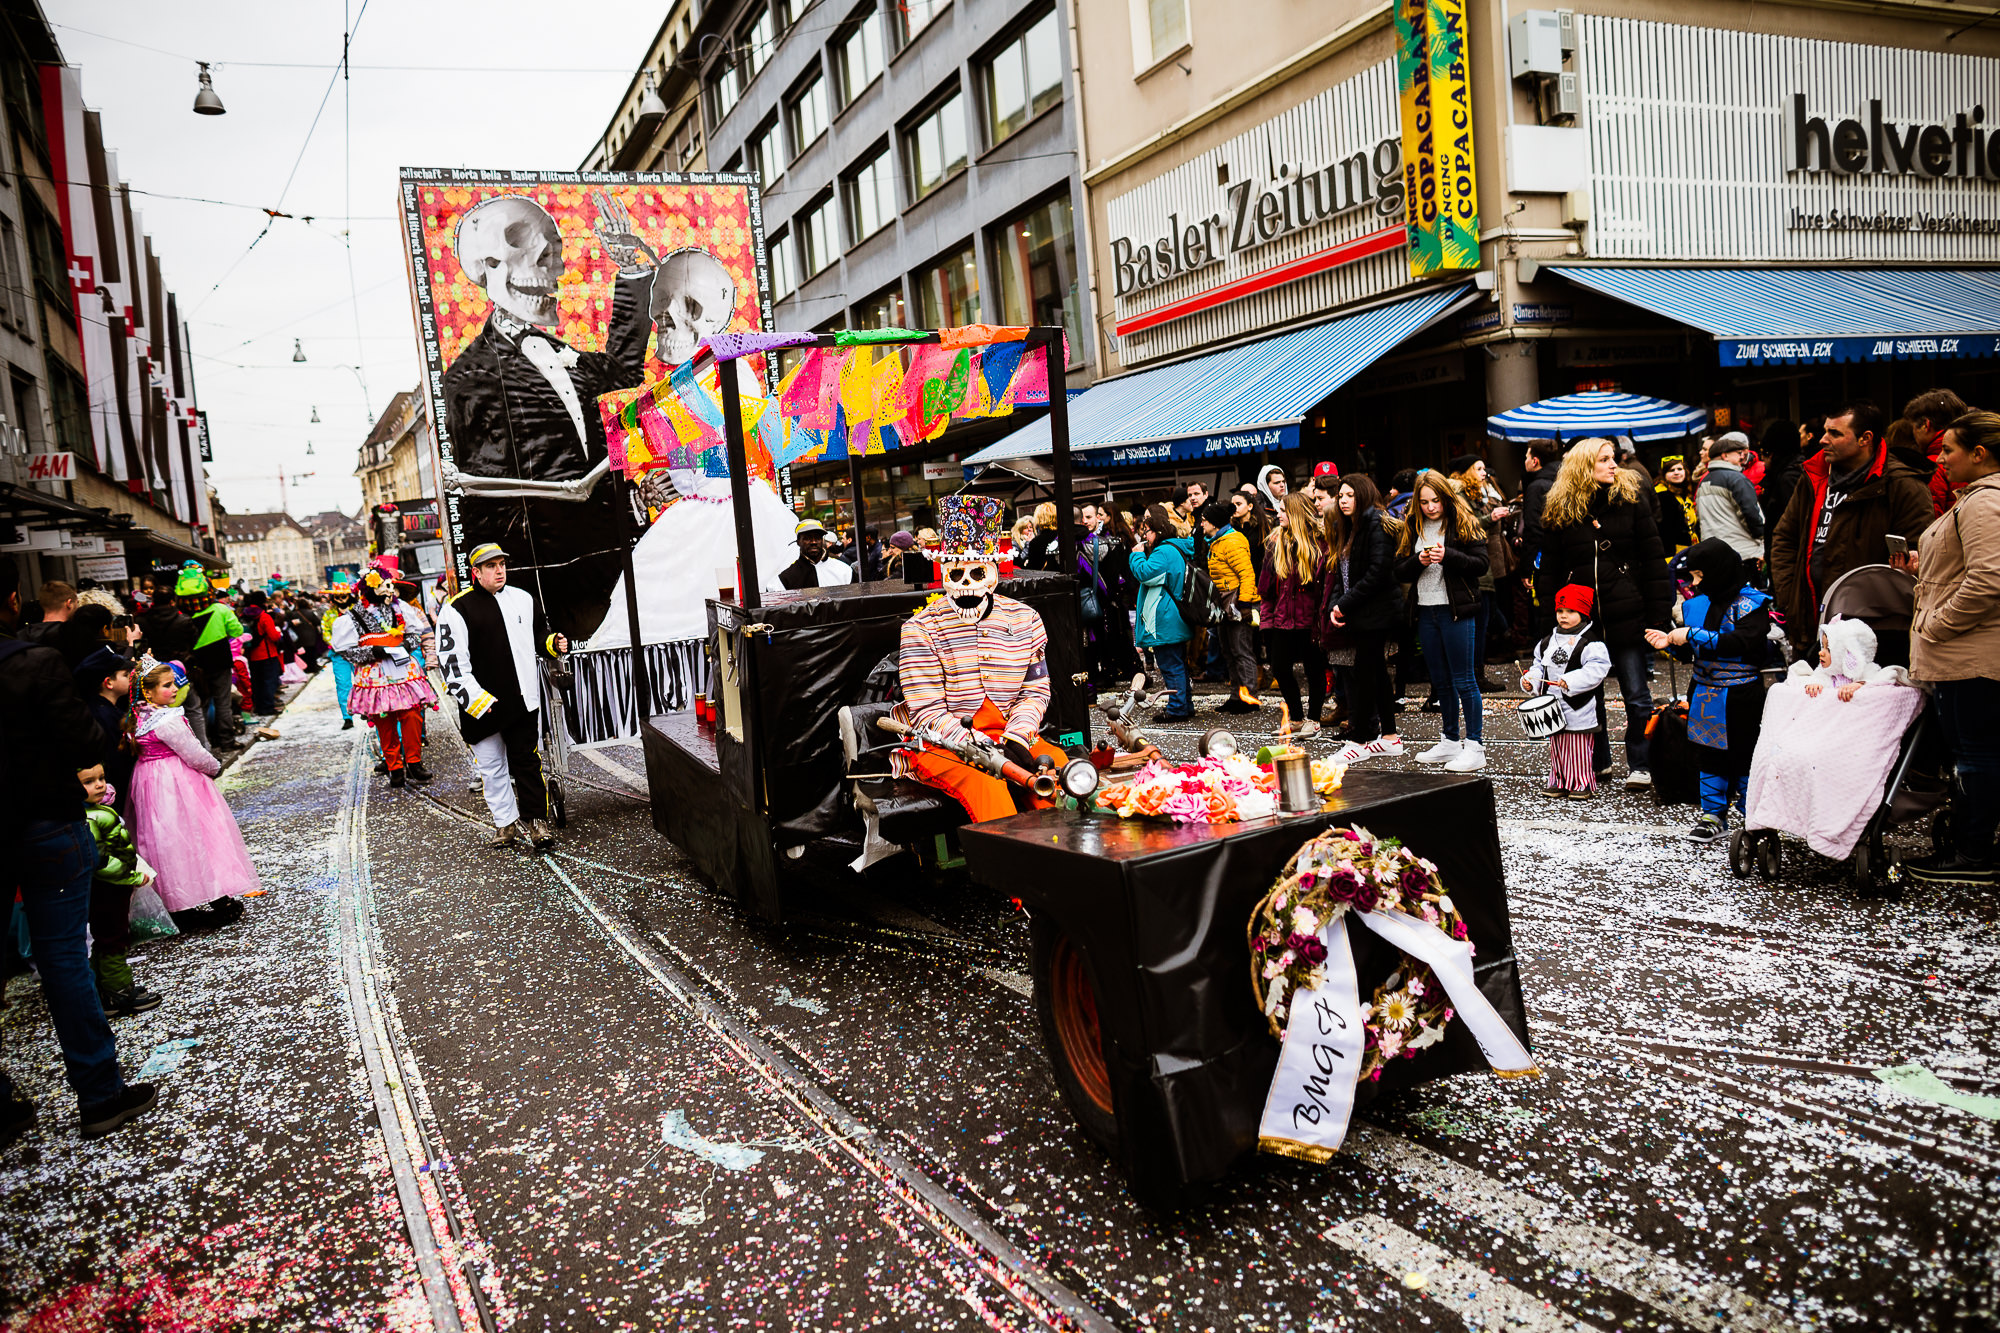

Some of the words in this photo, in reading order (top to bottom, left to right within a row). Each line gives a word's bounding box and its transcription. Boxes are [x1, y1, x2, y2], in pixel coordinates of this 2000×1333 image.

[452, 169, 478, 180] Morta
[481, 170, 502, 180] Bella
[511, 171, 537, 181] Basler
[540, 171, 581, 182] Mittwuch
[583, 172, 628, 183] Gsellschaft
[636, 172, 661, 183] Morta
[663, 172, 682, 183] Bella
[690, 173, 713, 183] Basler
[716, 173, 753, 184] Mittwuch
[402, 184, 415, 210] Basler
[1406, 162, 1420, 249] DANCING
[1440, 154, 1455, 241] DANCING
[1110, 213, 1221, 298] Basler
[1227, 137, 1406, 253] Zeitung
[1790, 206, 1824, 229] Ihre
[1830, 208, 1913, 231] Schweizer
[407, 213, 423, 254] Mittwuch
[754, 227, 766, 266] Mittwuch
[413, 256, 430, 309] Gsellschaft
[759, 267, 769, 292] Basler
[763, 300, 773, 319] Bella
[1516, 305, 1539, 318] Untere
[422, 314, 435, 339] Morta
[426, 341, 439, 362] Bella
[1736, 344, 1758, 359] ZUM
[1761, 342, 1811, 358] SCHIEFEN
[1812, 342, 1834, 357] ECK
[1872, 341, 1893, 355] ZUM
[1896, 340, 1939, 354] SCHIEFEN
[1940, 339, 1960, 353] ECK
[430, 371, 442, 397] Basler
[434, 399, 448, 441] Mittwuch
[1112, 449, 1126, 461] ZUM
[1126, 446, 1157, 459] SCHIEFEN
[1158, 444, 1172, 457] ECK
[1206, 438, 1222, 452] ZUM
[1224, 433, 1262, 449] SCHIEFEN
[1263, 430, 1282, 445] ECK
[28, 454, 69, 480] H&M
[781, 467, 791, 486] Bella
[448, 497, 459, 522] Morta
[402, 515, 439, 530] MORTA
[453, 523, 463, 545] Bella
[457, 552, 467, 579] Basler
